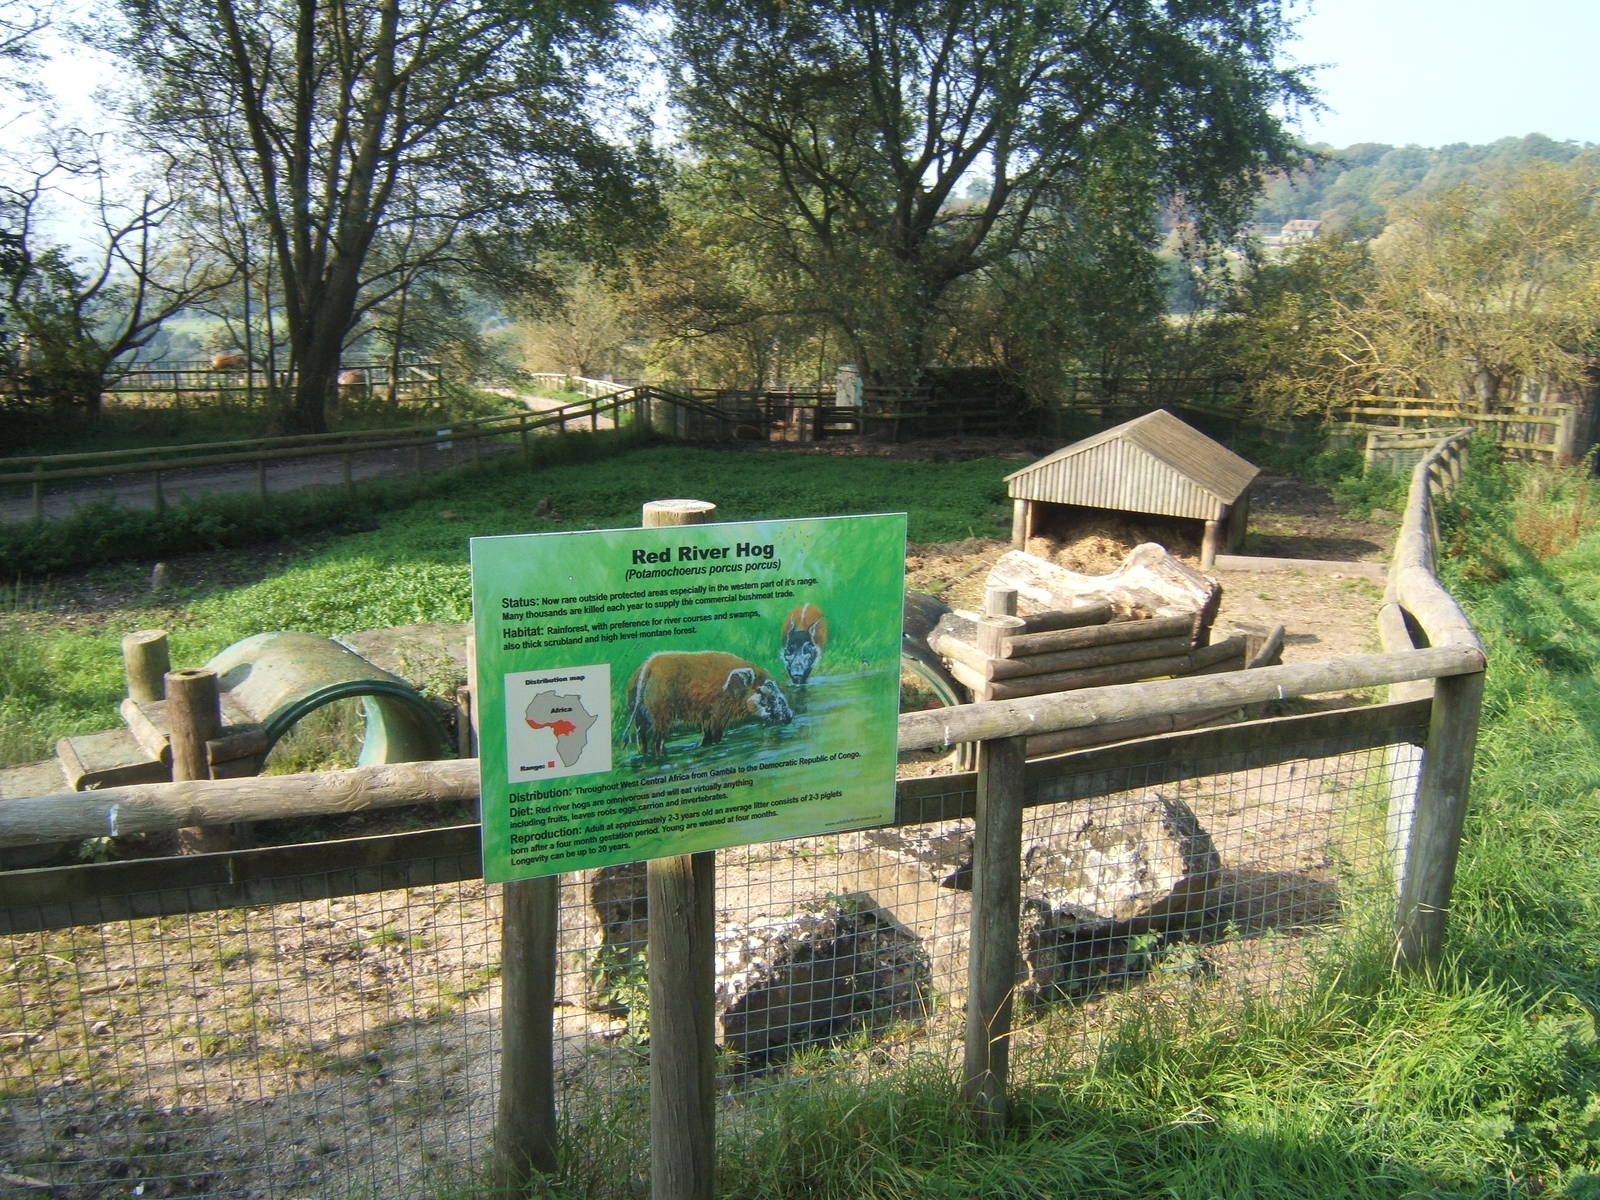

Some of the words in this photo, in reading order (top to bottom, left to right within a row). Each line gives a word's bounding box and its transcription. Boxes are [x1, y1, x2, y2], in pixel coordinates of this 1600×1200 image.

[632, 548, 671, 564] Red
[678, 546, 730, 561] River
[736, 542, 774, 559] Hog
[625, 566, 707, 582] (Potamochoerus
[709, 564, 742, 576] porcus
[744, 559, 781, 574] porcus)
[502, 597, 539, 608] Status:
[542, 597, 560, 605] Now
[578, 593, 608, 602] outside
[610, 590, 646, 602] protected
[670, 585, 707, 596] especially
[730, 582, 759, 591] western
[760, 580, 774, 590] part
[776, 579, 783, 587] of
[797, 578, 818, 586] range.
[502, 612, 524, 621] Many
[526, 608, 568, 618] thousands
[584, 604, 605, 614] killed
[606, 603, 625, 612] each
[626, 603, 644, 612] year
[654, 599, 680, 609] supply
[681, 598, 693, 606] the
[694, 594, 737, 604] commercial
[738, 592, 773, 601] bushmeat
[775, 590, 794, 598] trade.
[503, 626, 544, 638] Habitat:
[547, 624, 590, 635] Rainforest,
[591, 622, 608, 631] with
[610, 620, 650, 631] preference
[652, 618, 662, 626] for
[664, 616, 681, 624] river
[683, 615, 712, 623] courses
[714, 612, 727, 620] and
[729, 611, 760, 619] swamps,
[503, 642, 521, 650] also
[522, 640, 542, 649] thick
[544, 635, 583, 647] scrubland
[584, 634, 599, 643] and
[601, 633, 618, 643] high
[620, 631, 638, 640] level
[639, 629, 672, 638] montane
[525, 677, 568, 685] Distribution
[509, 790, 572, 804] Distribution:
[575, 784, 619, 794] Throughout
[620, 780, 639, 790] West
[640, 774, 667, 786] Central
[668, 773, 690, 782] Africa
[691, 771, 708, 779] from
[709, 768, 736, 778] Gambia
[759, 759, 798, 770] Democratic
[799, 754, 828, 765] Republic
[838, 752, 861, 760] Congo.
[510, 806, 533, 818] Diet:
[535, 805, 551, 815] Red
[571, 802, 591, 810] hogs
[606, 793, 650, 804] omnivorous
[651, 790, 666, 798] and
[693, 782, 722, 792] virtually
[723, 779, 753, 789] anything
[510, 819, 546, 828] including
[547, 815, 569, 823] fruits,
[571, 812, 596, 820] leaves
[597, 808, 617, 816] roots
[665, 798, 679, 807] and
[681, 793, 728, 805] invertebrates.
[510, 828, 581, 844] Reproduction:
[585, 824, 604, 834] Adult
[615, 816, 666, 830] approximately
[668, 813, 679, 822] 2-3
[680, 812, 700, 822] years
[701, 808, 713, 817] old
[725, 804, 752, 813] average
[770, 797, 799, 806] consists
[820, 790, 842, 801] piglets
[510, 844, 529, 855] born
[530, 844, 548, 852] after
[573, 837, 597, 846] month
[599, 832, 633, 844] gestation
[662, 824, 685, 832] Young
[698, 817, 726, 827] weaned
[751, 810, 778, 820] months.
[511, 854, 549, 866] Longevity
[598, 845, 607, 853] 20
[608, 843, 631, 853] years.
